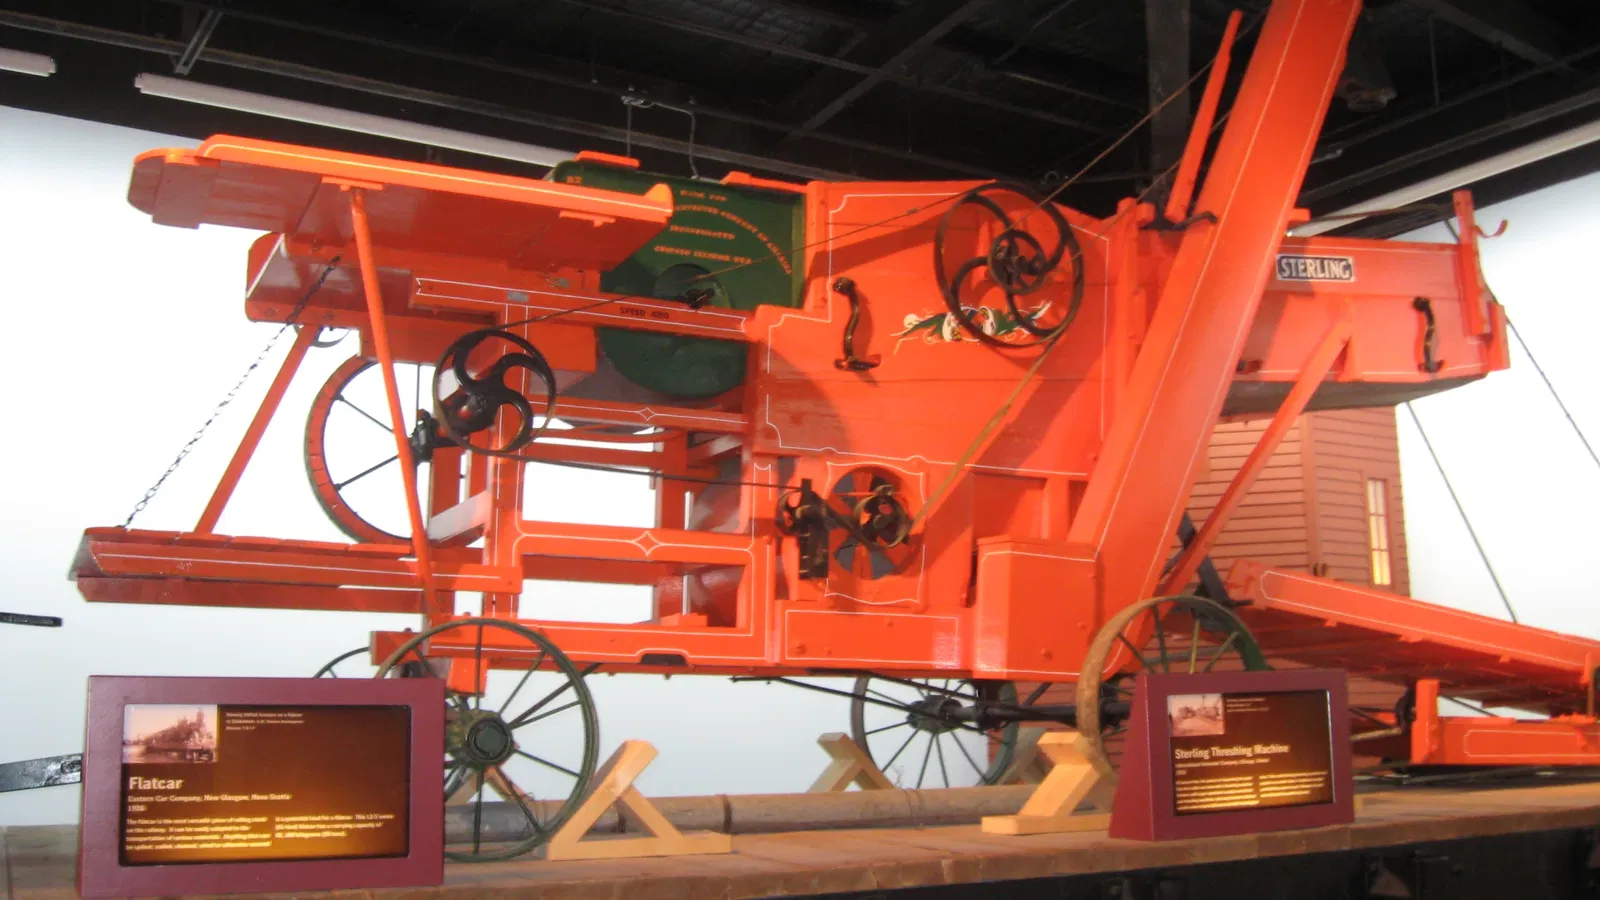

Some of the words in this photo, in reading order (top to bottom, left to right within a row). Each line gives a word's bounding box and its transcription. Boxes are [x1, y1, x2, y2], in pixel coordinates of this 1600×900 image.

[1281, 258, 1350, 279] STERLING
[619, 307, 646, 317] SPEED
[1174, 748, 1210, 760] Sterling
[1210, 746, 1253, 758] Threshing
[1253, 744, 1290, 755] Machine
[129, 776, 183, 790] Flatcar
[128, 795, 154, 803] Eastern
[169, 794, 202, 804] Company,
